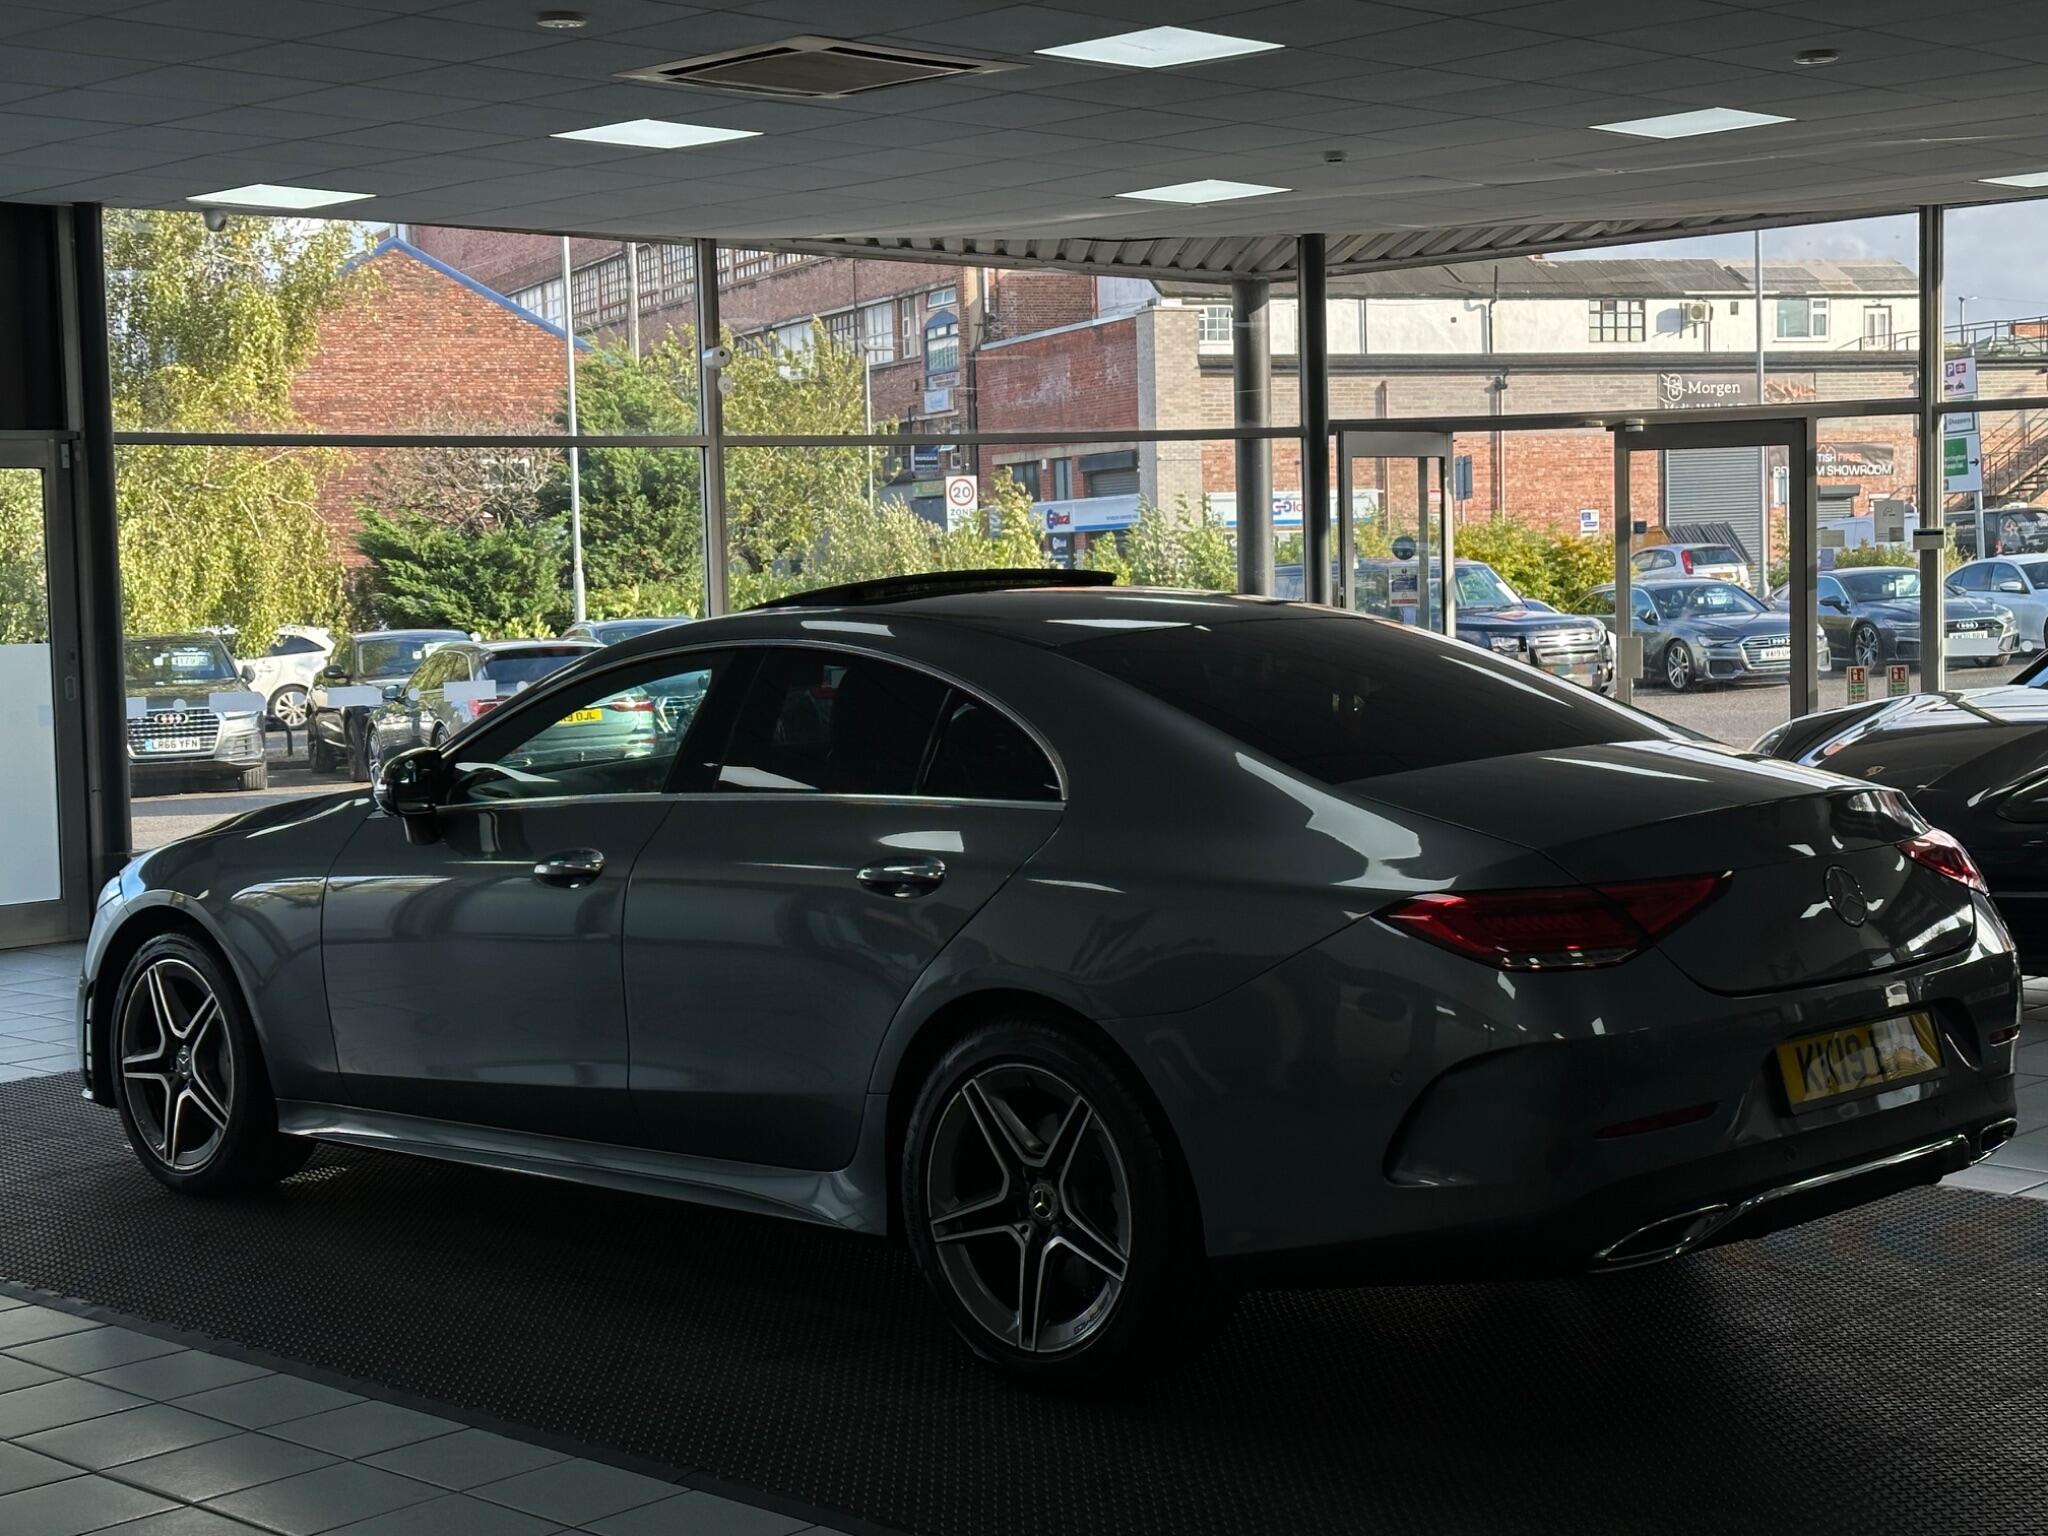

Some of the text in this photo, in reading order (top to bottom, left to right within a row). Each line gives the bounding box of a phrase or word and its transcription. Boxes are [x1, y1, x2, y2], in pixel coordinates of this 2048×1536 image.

[1688, 381, 1741, 397] Morgen
[1816, 453, 1837, 463] TISH
[1827, 464, 1893, 476] SHOWROOM
[953, 486, 971, 498] 20
